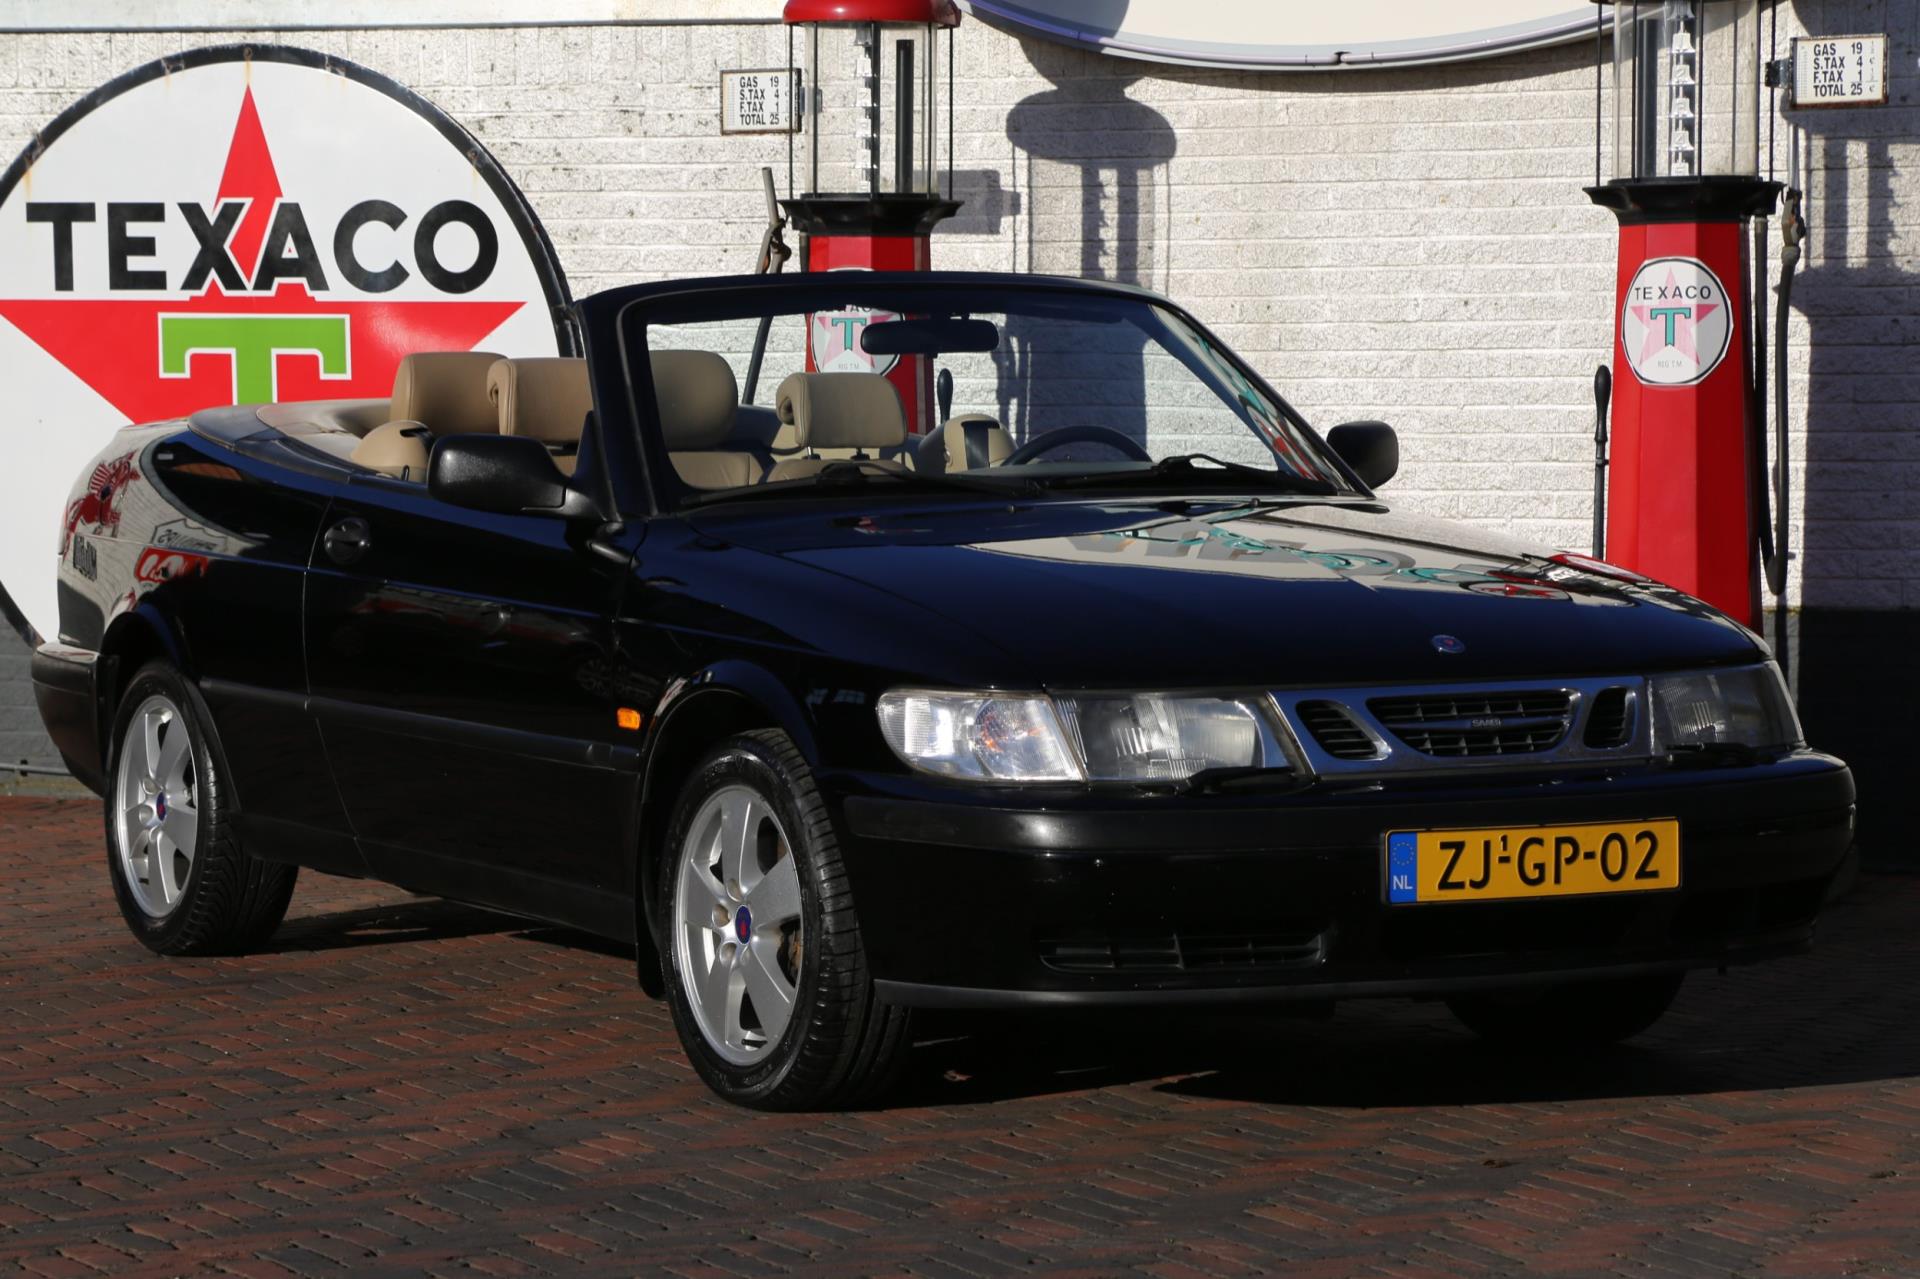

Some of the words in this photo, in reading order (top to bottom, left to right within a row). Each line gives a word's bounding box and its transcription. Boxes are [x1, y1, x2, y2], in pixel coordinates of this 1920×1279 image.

[1813, 43, 1836, 56] GAS
[1851, 42, 1863, 54] 19
[1813, 56, 1845, 70] S.TAX
[1856, 56, 1863, 67] 4
[740, 76, 758, 88] GAS
[770, 76, 779, 87] 19
[1813, 70, 1843, 83] F.TAX
[1858, 69, 1862, 82] 1
[740, 89, 765, 100] S.TAX
[774, 89, 780, 100] 4
[1813, 84, 1846, 97] TOTAL
[1850, 83, 1863, 95] 25
[740, 101, 764, 113] F.TAX
[775, 101, 779, 112] 1
[740, 113, 766, 126] TOTAL
[770, 113, 780, 125] 25
[26, 200, 498, 294] TEXACO
[1634, 285, 1711, 300] TEXACO
[1650, 307, 1692, 347] T
[831, 317, 867, 352] T
[157, 312, 352, 404] T
[1438, 830, 1660, 891] ZJ-GP-02
[1393, 875, 1413, 890] NL
